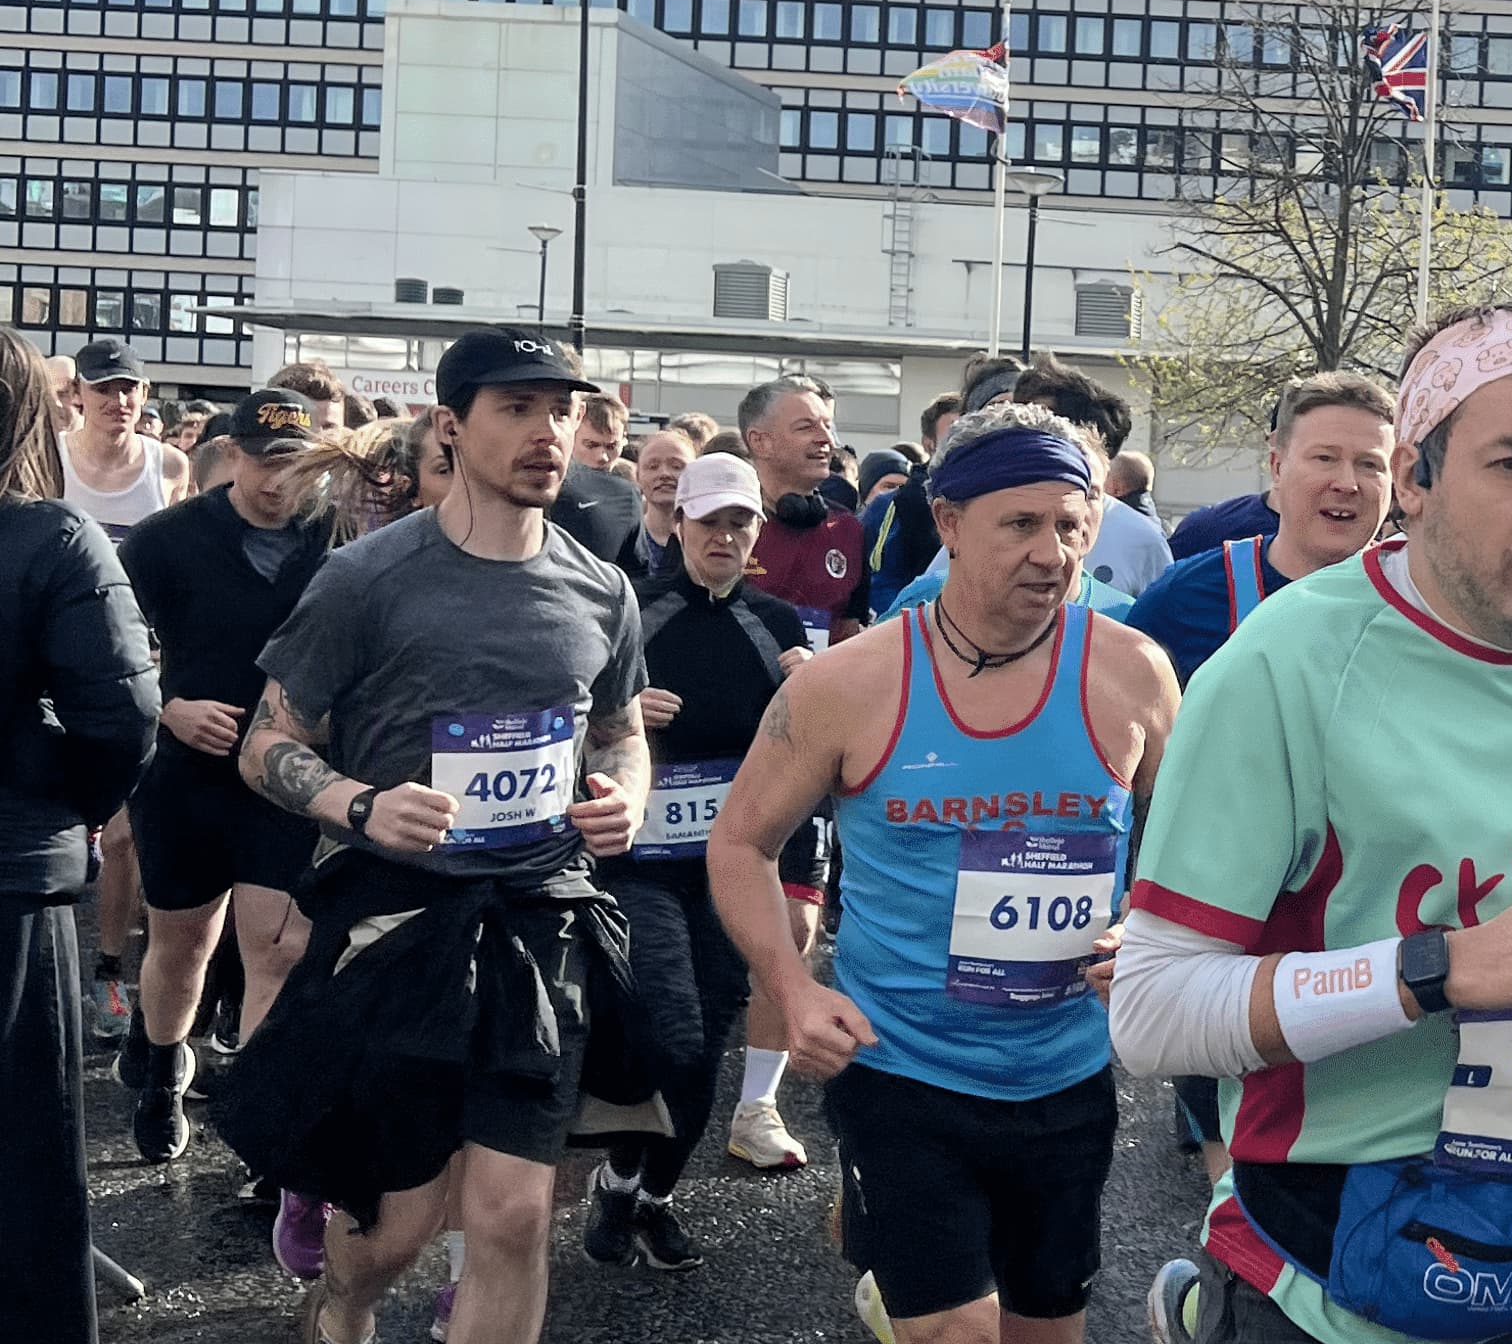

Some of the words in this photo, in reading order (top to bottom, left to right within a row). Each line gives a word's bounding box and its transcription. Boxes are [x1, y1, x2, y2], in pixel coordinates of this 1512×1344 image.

[352, 376, 418, 395] Careers
[257, 403, 311, 429] Tigers
[464, 764, 556, 802] 4072
[490, 809, 522, 823] JOSH
[525, 807, 537, 817] W
[666, 798, 719, 825] 815
[886, 791, 1107, 824] BARNSLEY
[1025, 852, 1067, 862] SHEFFIELD
[990, 895, 1093, 932] 6108
[1293, 959, 1373, 999] PamB
[1468, 1071, 1475, 1085] L
